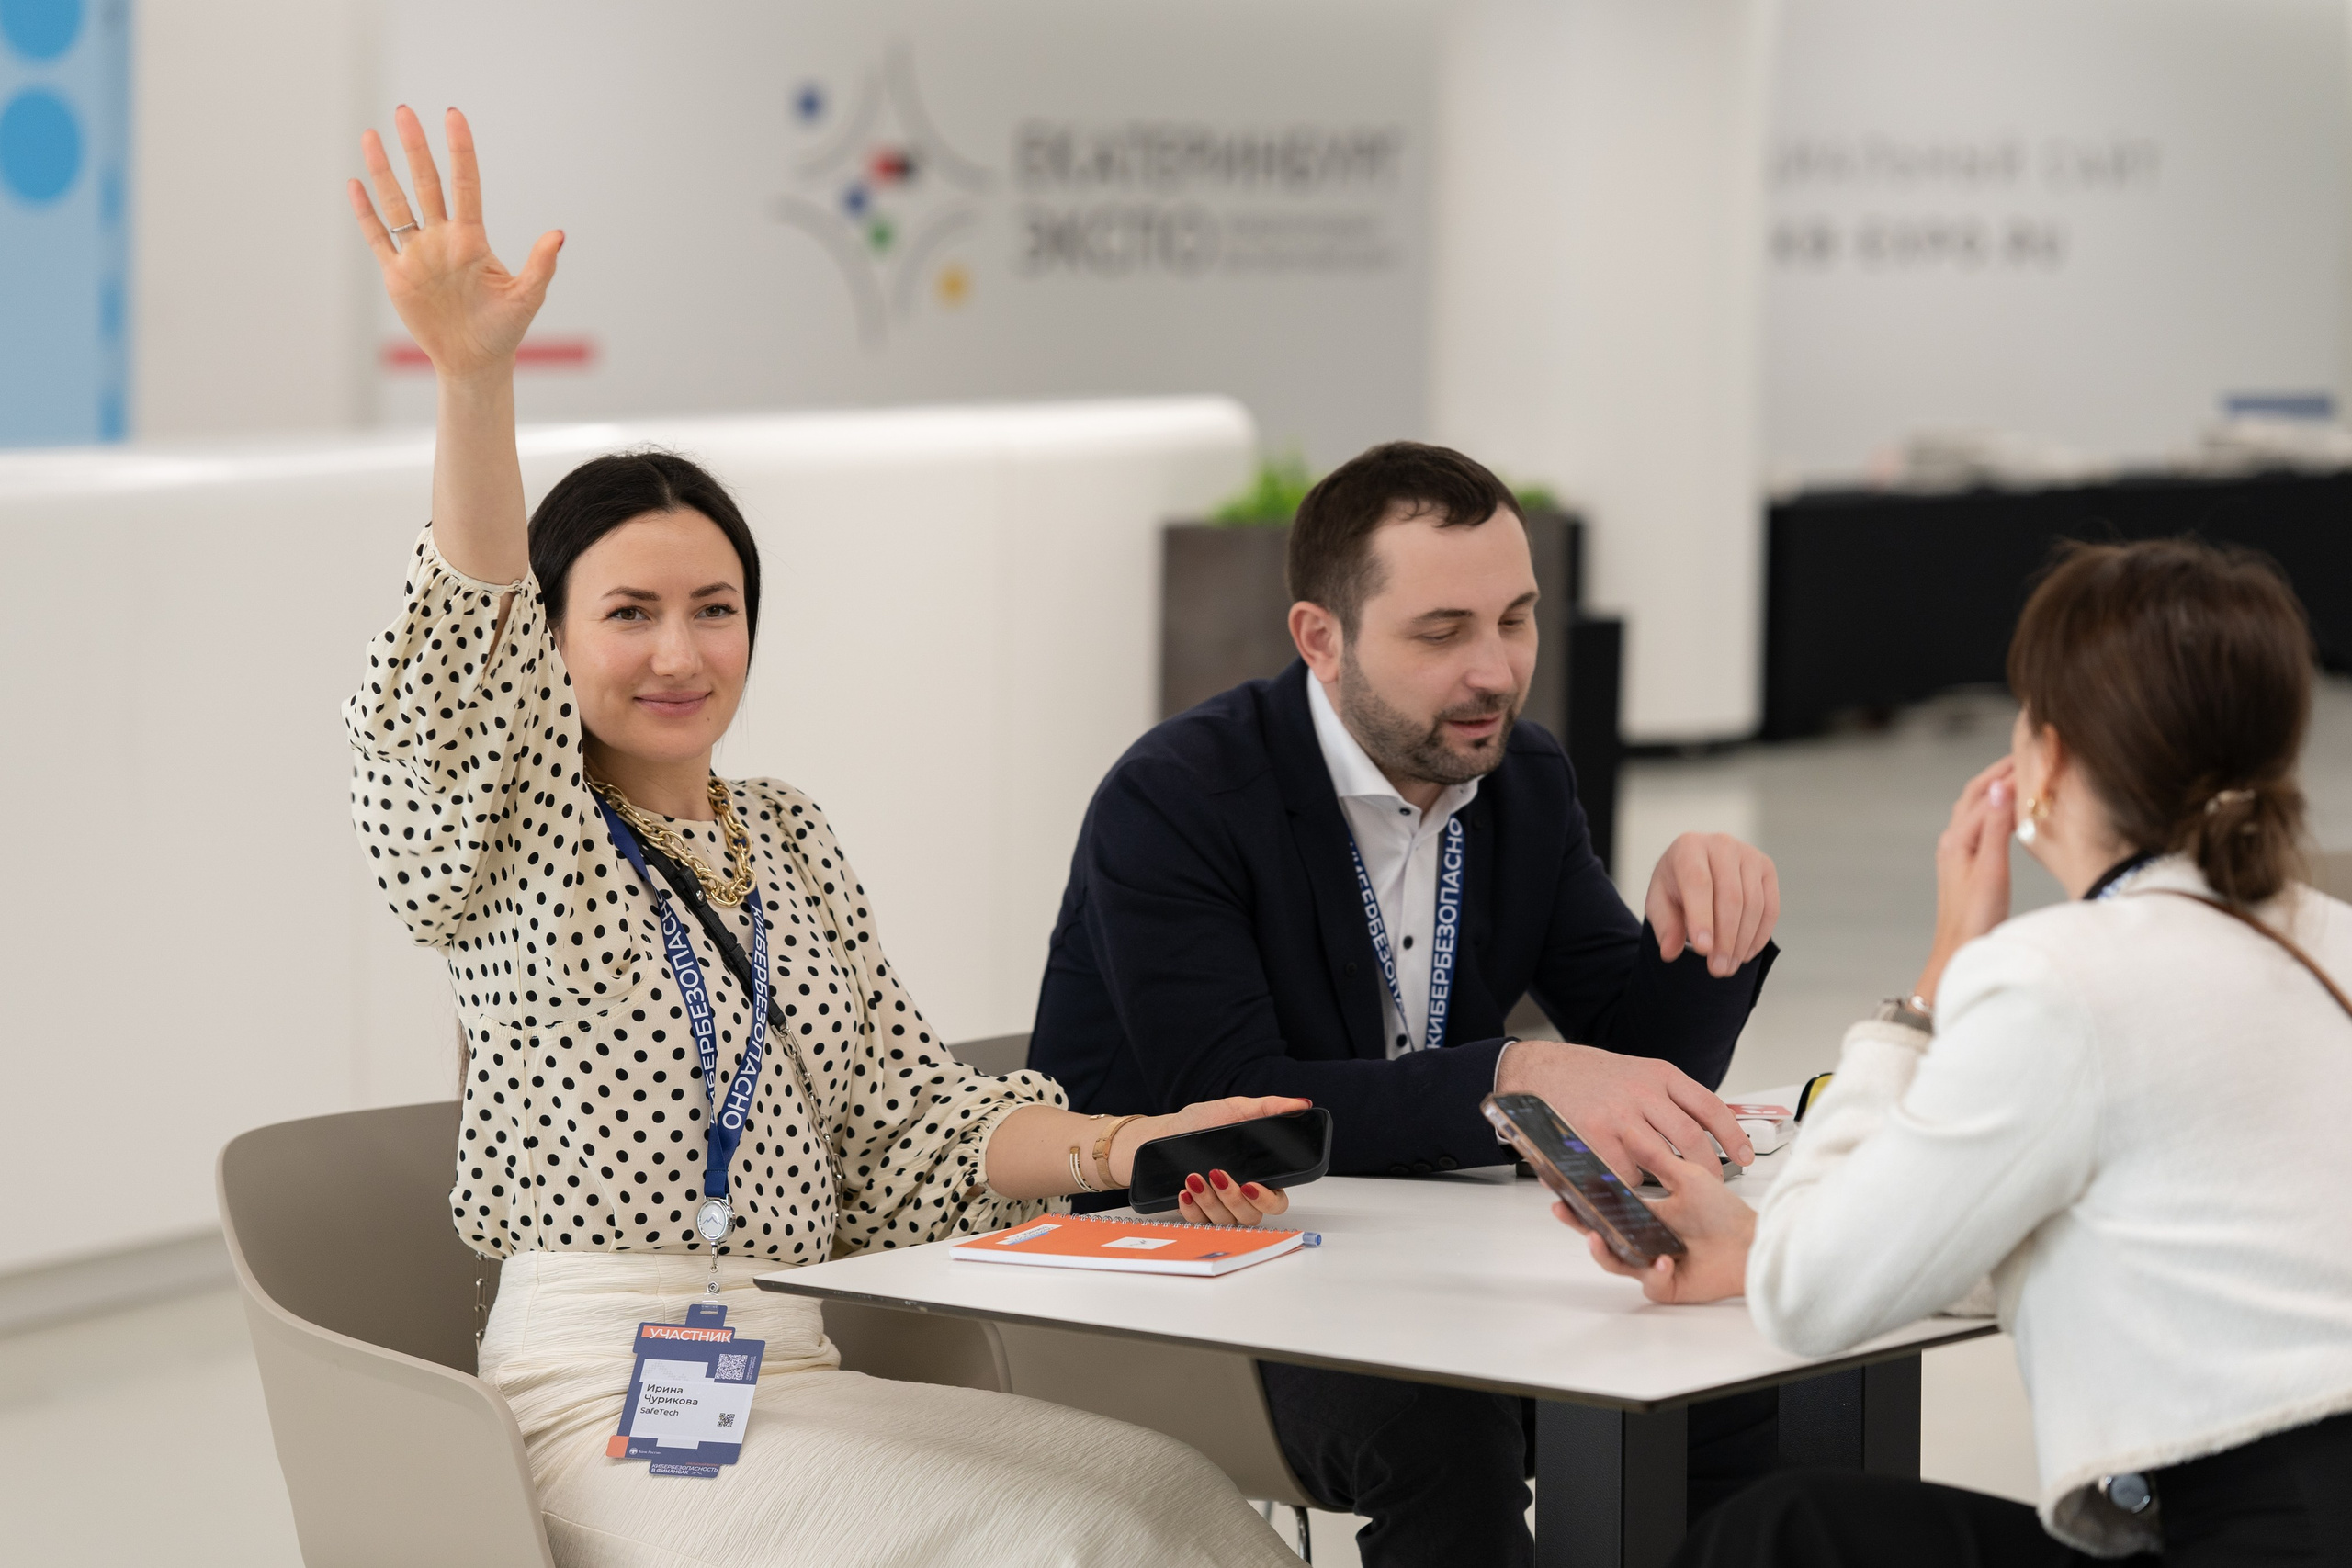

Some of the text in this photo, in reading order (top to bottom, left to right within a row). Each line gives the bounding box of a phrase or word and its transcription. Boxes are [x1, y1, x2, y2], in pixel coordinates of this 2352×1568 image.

[1426, 817, 1464, 1050] КИБЕРБЕЗОПАСНО
[721, 903, 768, 1131] КИБЕРБЕЗОПАСНО
[649, 1327, 733, 1344] УЧАСТНИК
[646, 1383, 684, 1394] Ирина
[644, 1394, 699, 1406] Чурикова
[639, 1406, 679, 1416] SafeTech
[651, 1463, 718, 1472] КИБЕРБЕЗОПАСНОСТЬ
